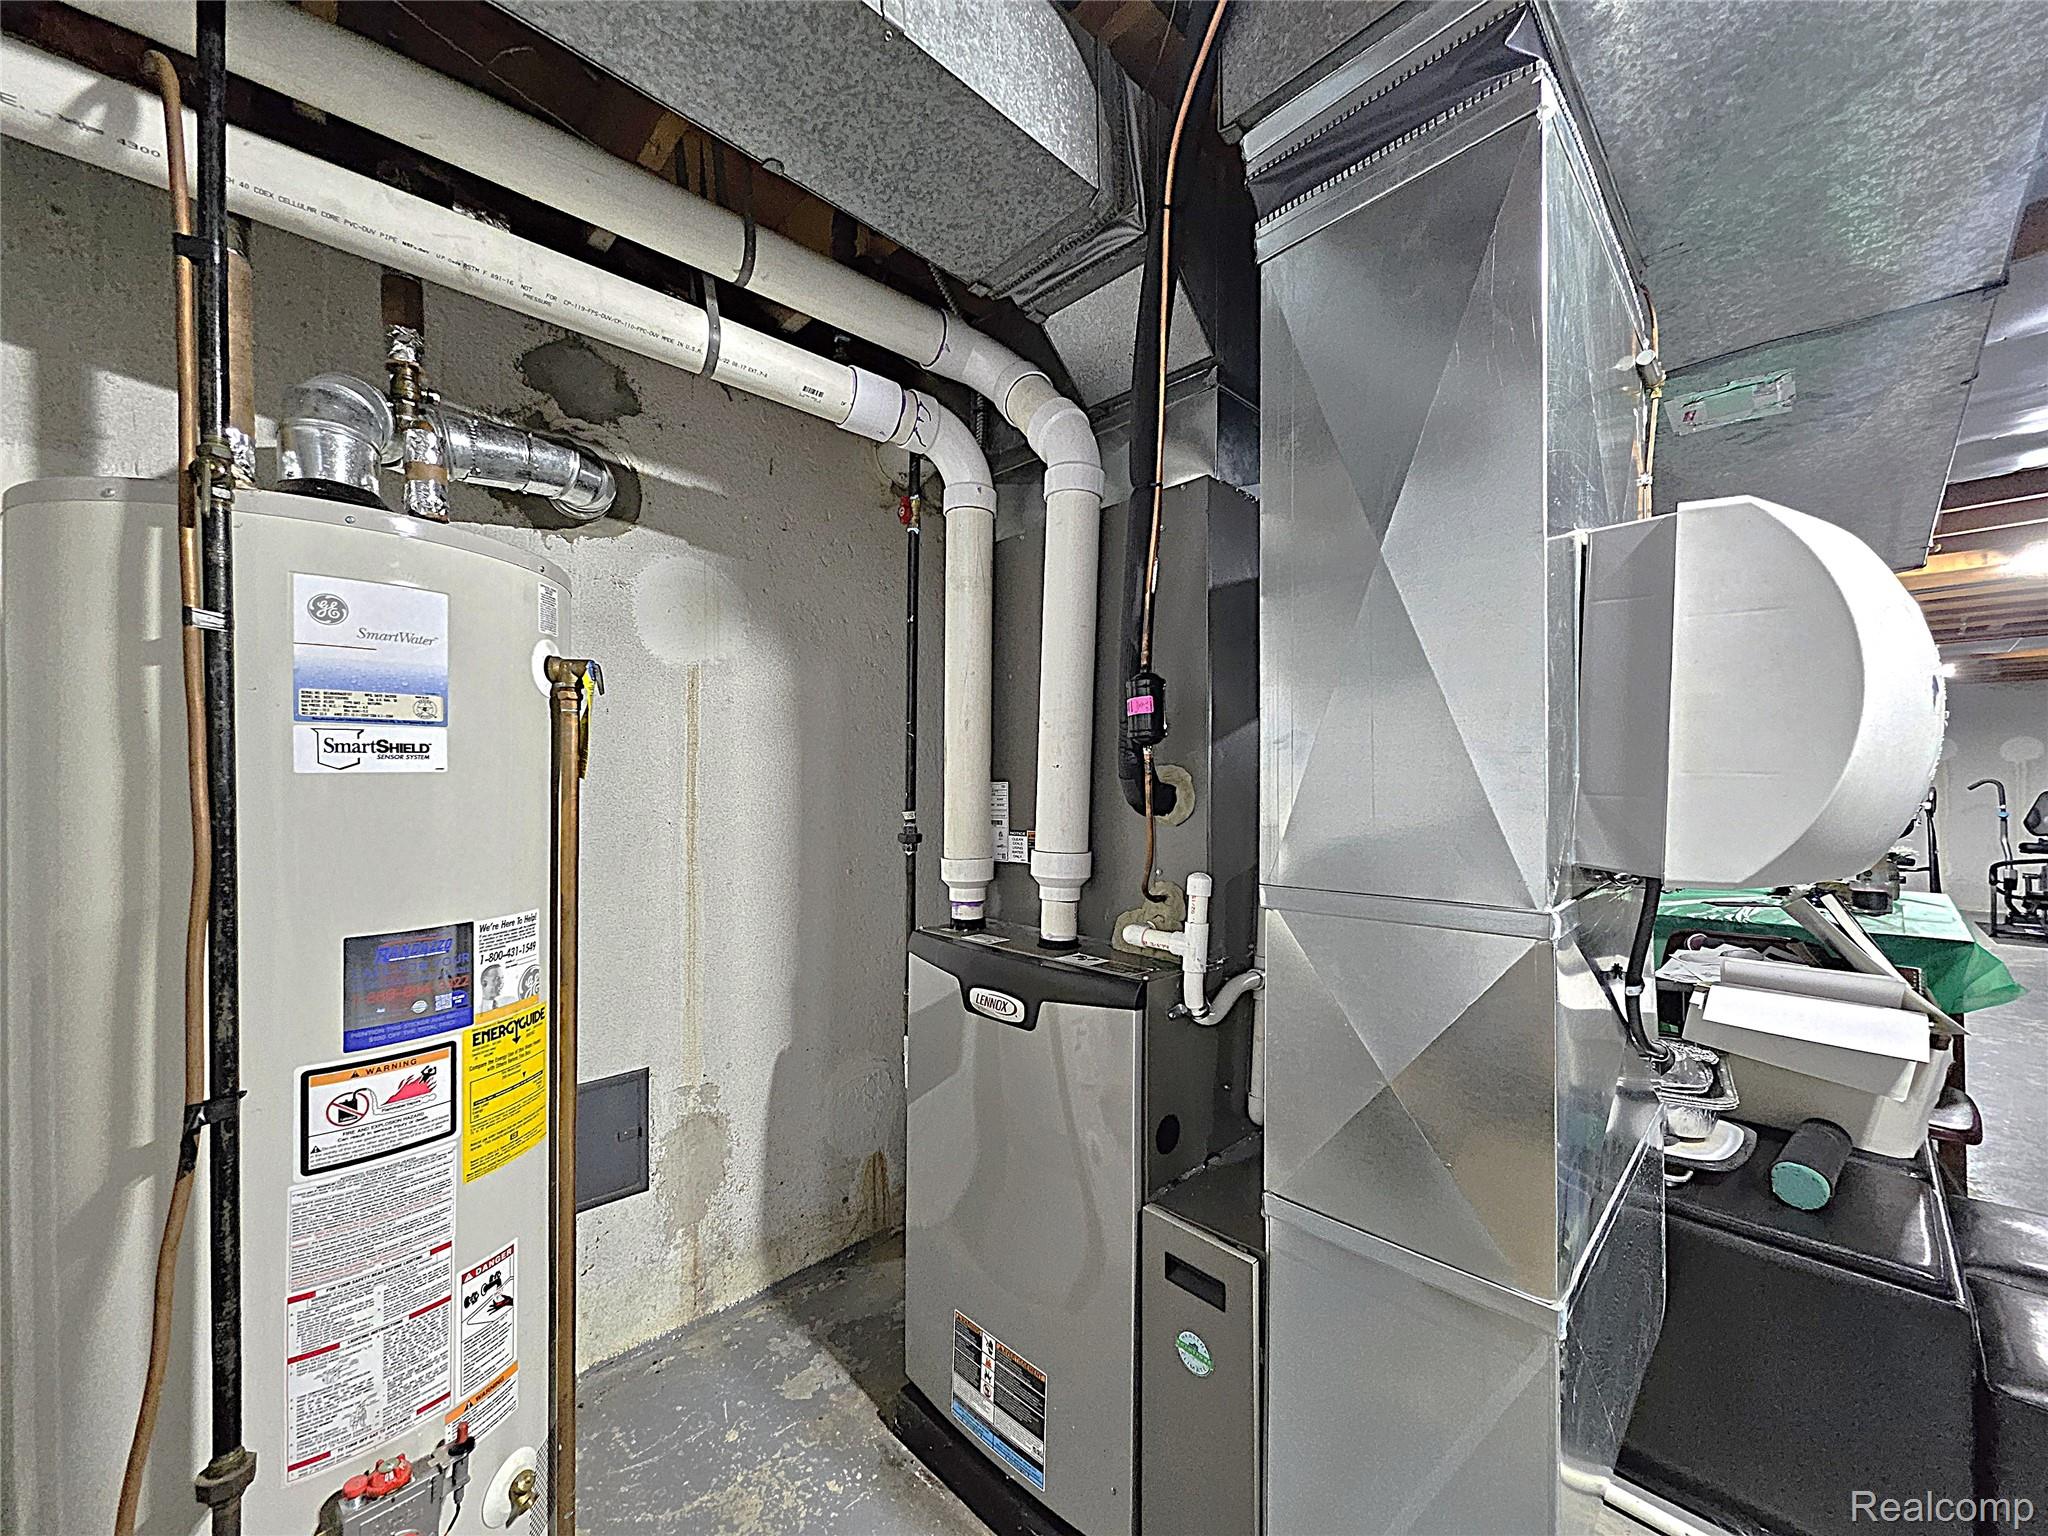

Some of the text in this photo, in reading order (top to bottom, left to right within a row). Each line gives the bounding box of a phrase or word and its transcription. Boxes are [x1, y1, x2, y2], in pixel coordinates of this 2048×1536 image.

[117, 138, 161, 158] 4300
[239, 181, 250, 190] 40
[254, 186, 274, 200] COEX
[278, 195, 317, 215] CELLULAR
[321, 210, 341, 224] CORE
[380, 232, 398, 244] PIPE
[520, 284, 533, 293] NOT
[546, 292, 558, 302] FOR
[356, 627, 436, 647] SmartWater
[324, 737, 430, 754] SmartSHIELD
[479, 923, 499, 932] We're
[501, 919, 515, 929] Here
[517, 915, 523, 925] To
[975, 993, 1009, 1013] LENNOX
[472, 1007, 545, 1047] ENERGYGUIDE
[366, 1059, 417, 1075] WARNING
[357, 1125, 369, 1133] AND
[370, 1117, 402, 1129] EXPLOSION
[336, 1135, 348, 1143] Can
[475, 1248, 512, 1276] DANGER
[475, 1375, 505, 1402] WARNING
